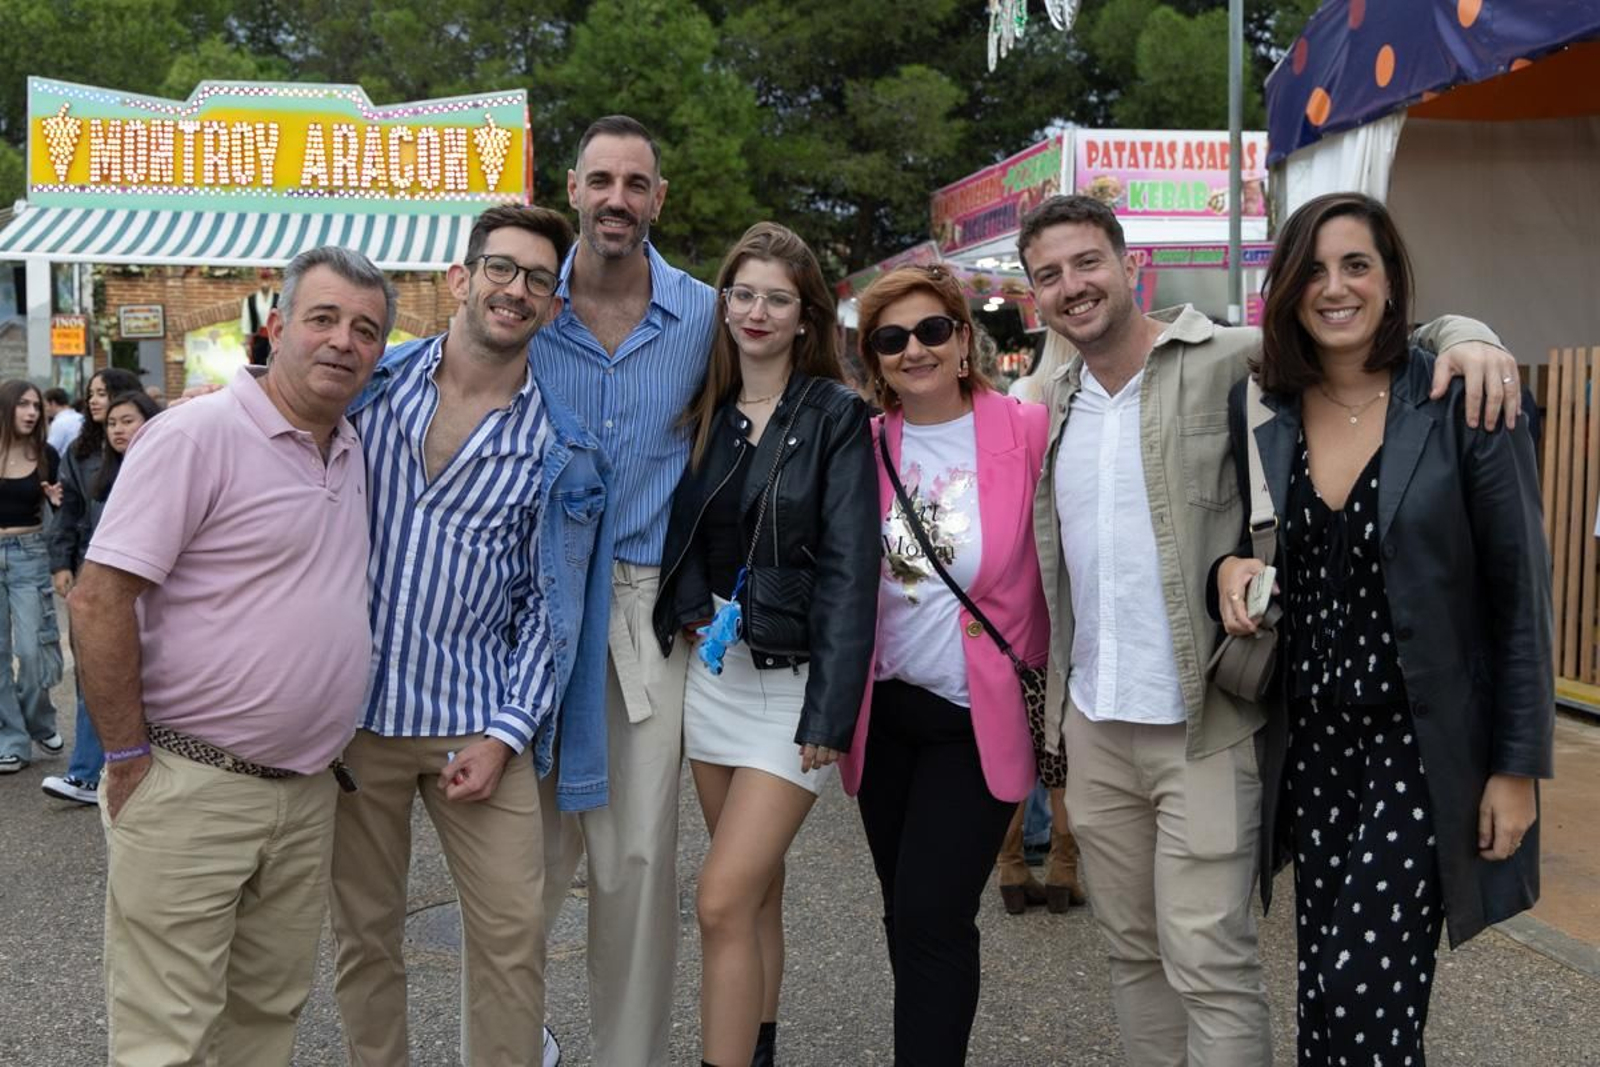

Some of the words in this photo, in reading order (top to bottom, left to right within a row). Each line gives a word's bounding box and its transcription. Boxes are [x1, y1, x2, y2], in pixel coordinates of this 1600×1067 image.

[89, 118, 279, 186] MONTROY
[1086, 140, 1177, 170] PATATAS
[1129, 180, 1208, 209] KEBAB
